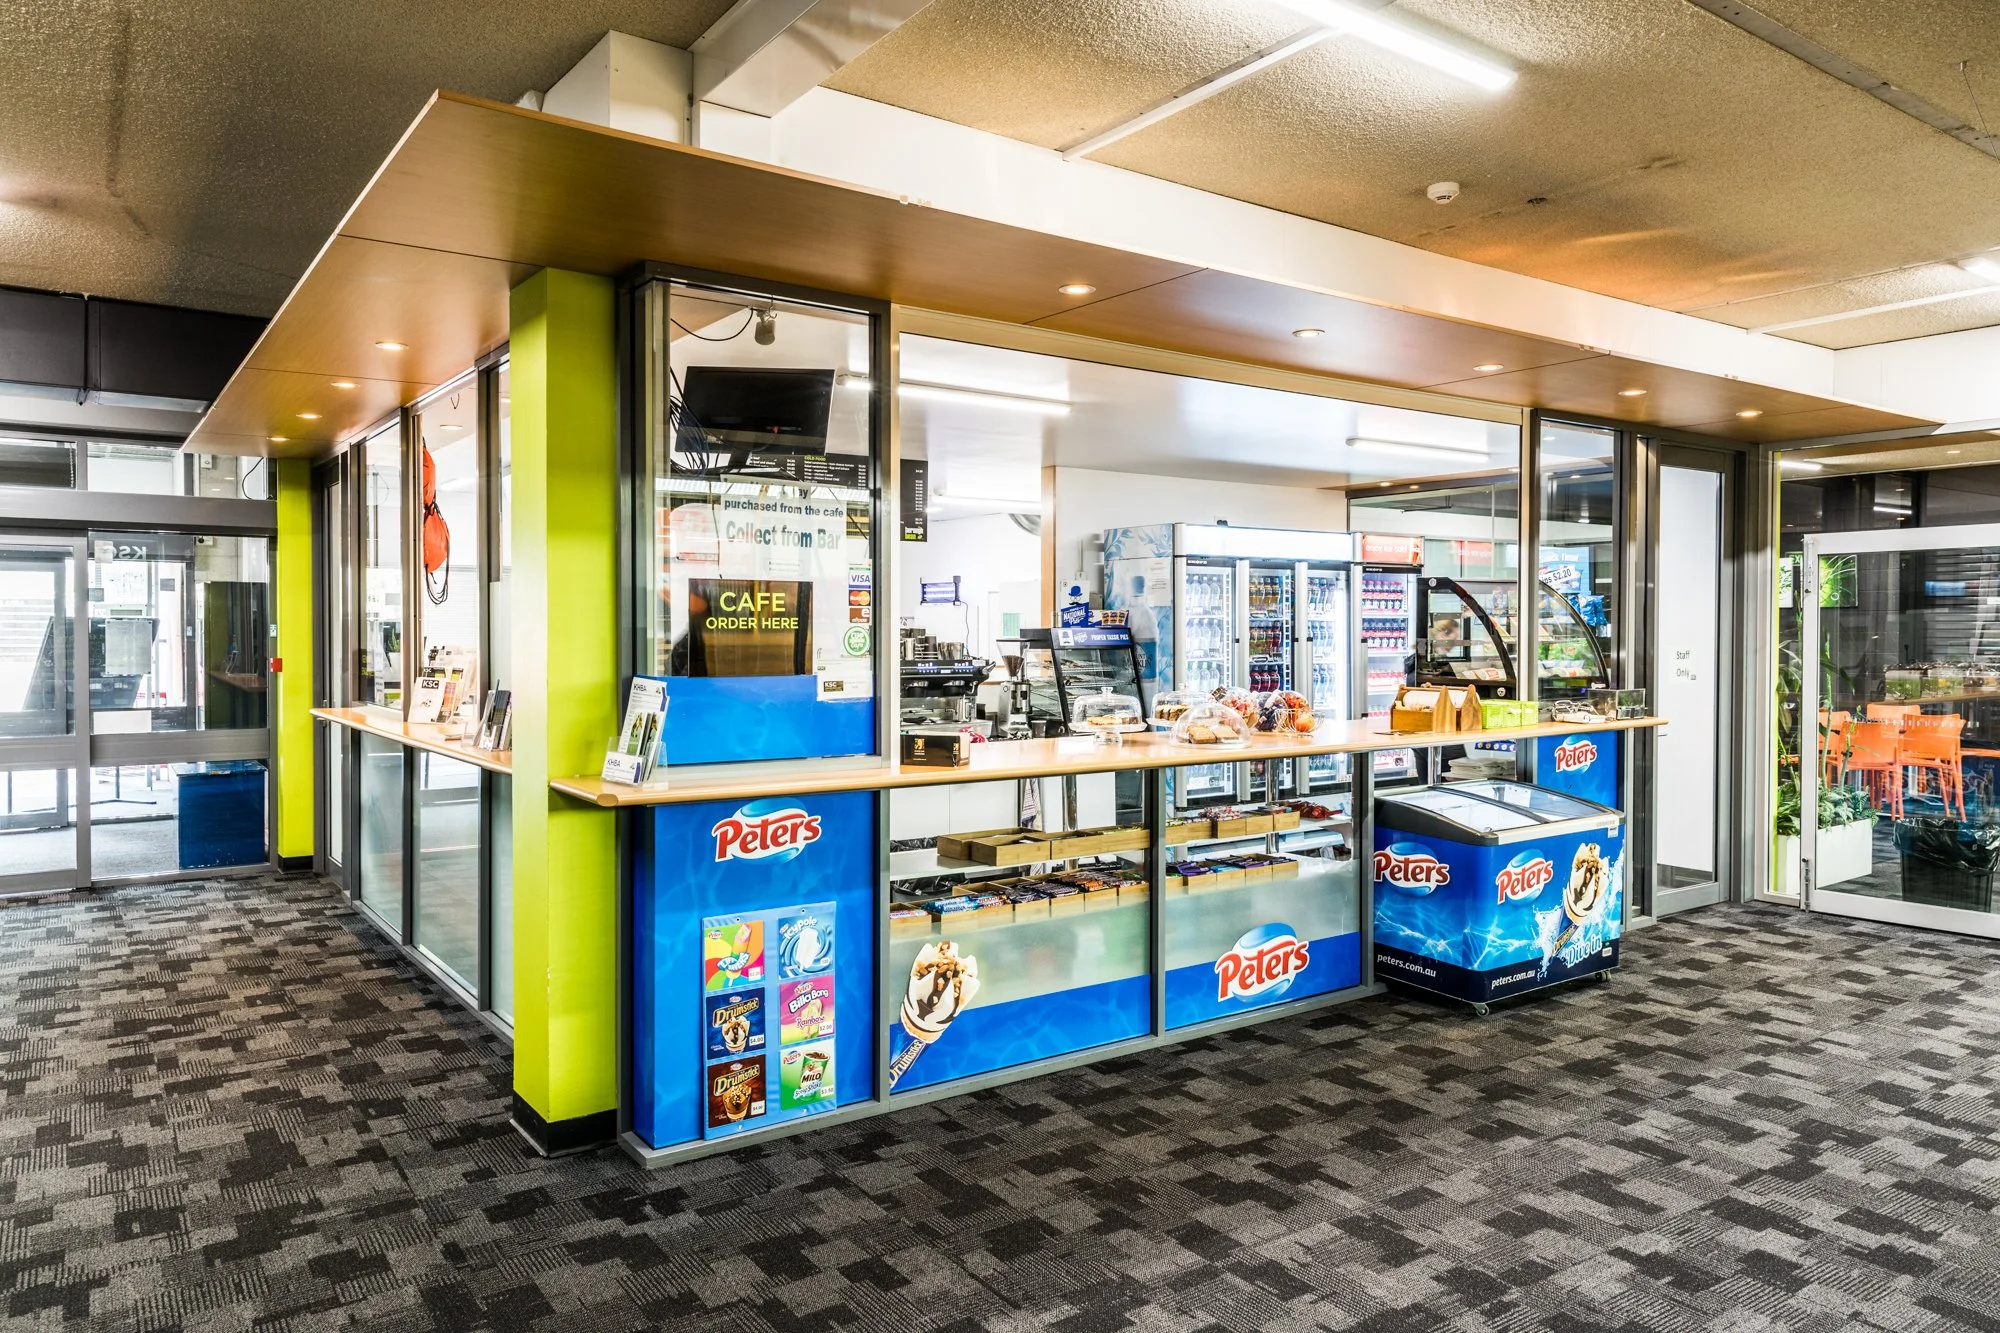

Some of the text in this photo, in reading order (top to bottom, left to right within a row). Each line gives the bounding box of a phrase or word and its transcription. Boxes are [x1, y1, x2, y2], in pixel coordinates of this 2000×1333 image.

[724, 499, 844, 518] purchased from the cafe
[726, 520, 841, 549] Collect from Bar
[851, 574, 870, 583] VISA
[1553, 568, 1572, 581] $2.20
[719, 592, 786, 612] CAFE
[706, 617, 799, 629] ORDER HERE
[1676, 650, 1690, 660] Staff
[1676, 668, 1690, 679] Only
[422, 680, 439, 688] KSC
[1555, 743, 1596, 771] Peters
[713, 813, 820, 860] Peters
[1373, 851, 1449, 884] Peters
[1497, 860, 1553, 902] Peters
[1567, 933, 1603, 967] Dive in
[1216, 941, 1309, 999] Peters
[1377, 954, 1437, 978] peters.com.au
[1491, 969, 1536, 990] peters.com.au
[716, 1000, 758, 1026] Drumstick
[796, 1016, 825, 1028] Rainbow
[783, 1052, 801, 1065] Peters
[716, 1066, 759, 1095] Drumstick
[802, 1072, 821, 1083] MILO
